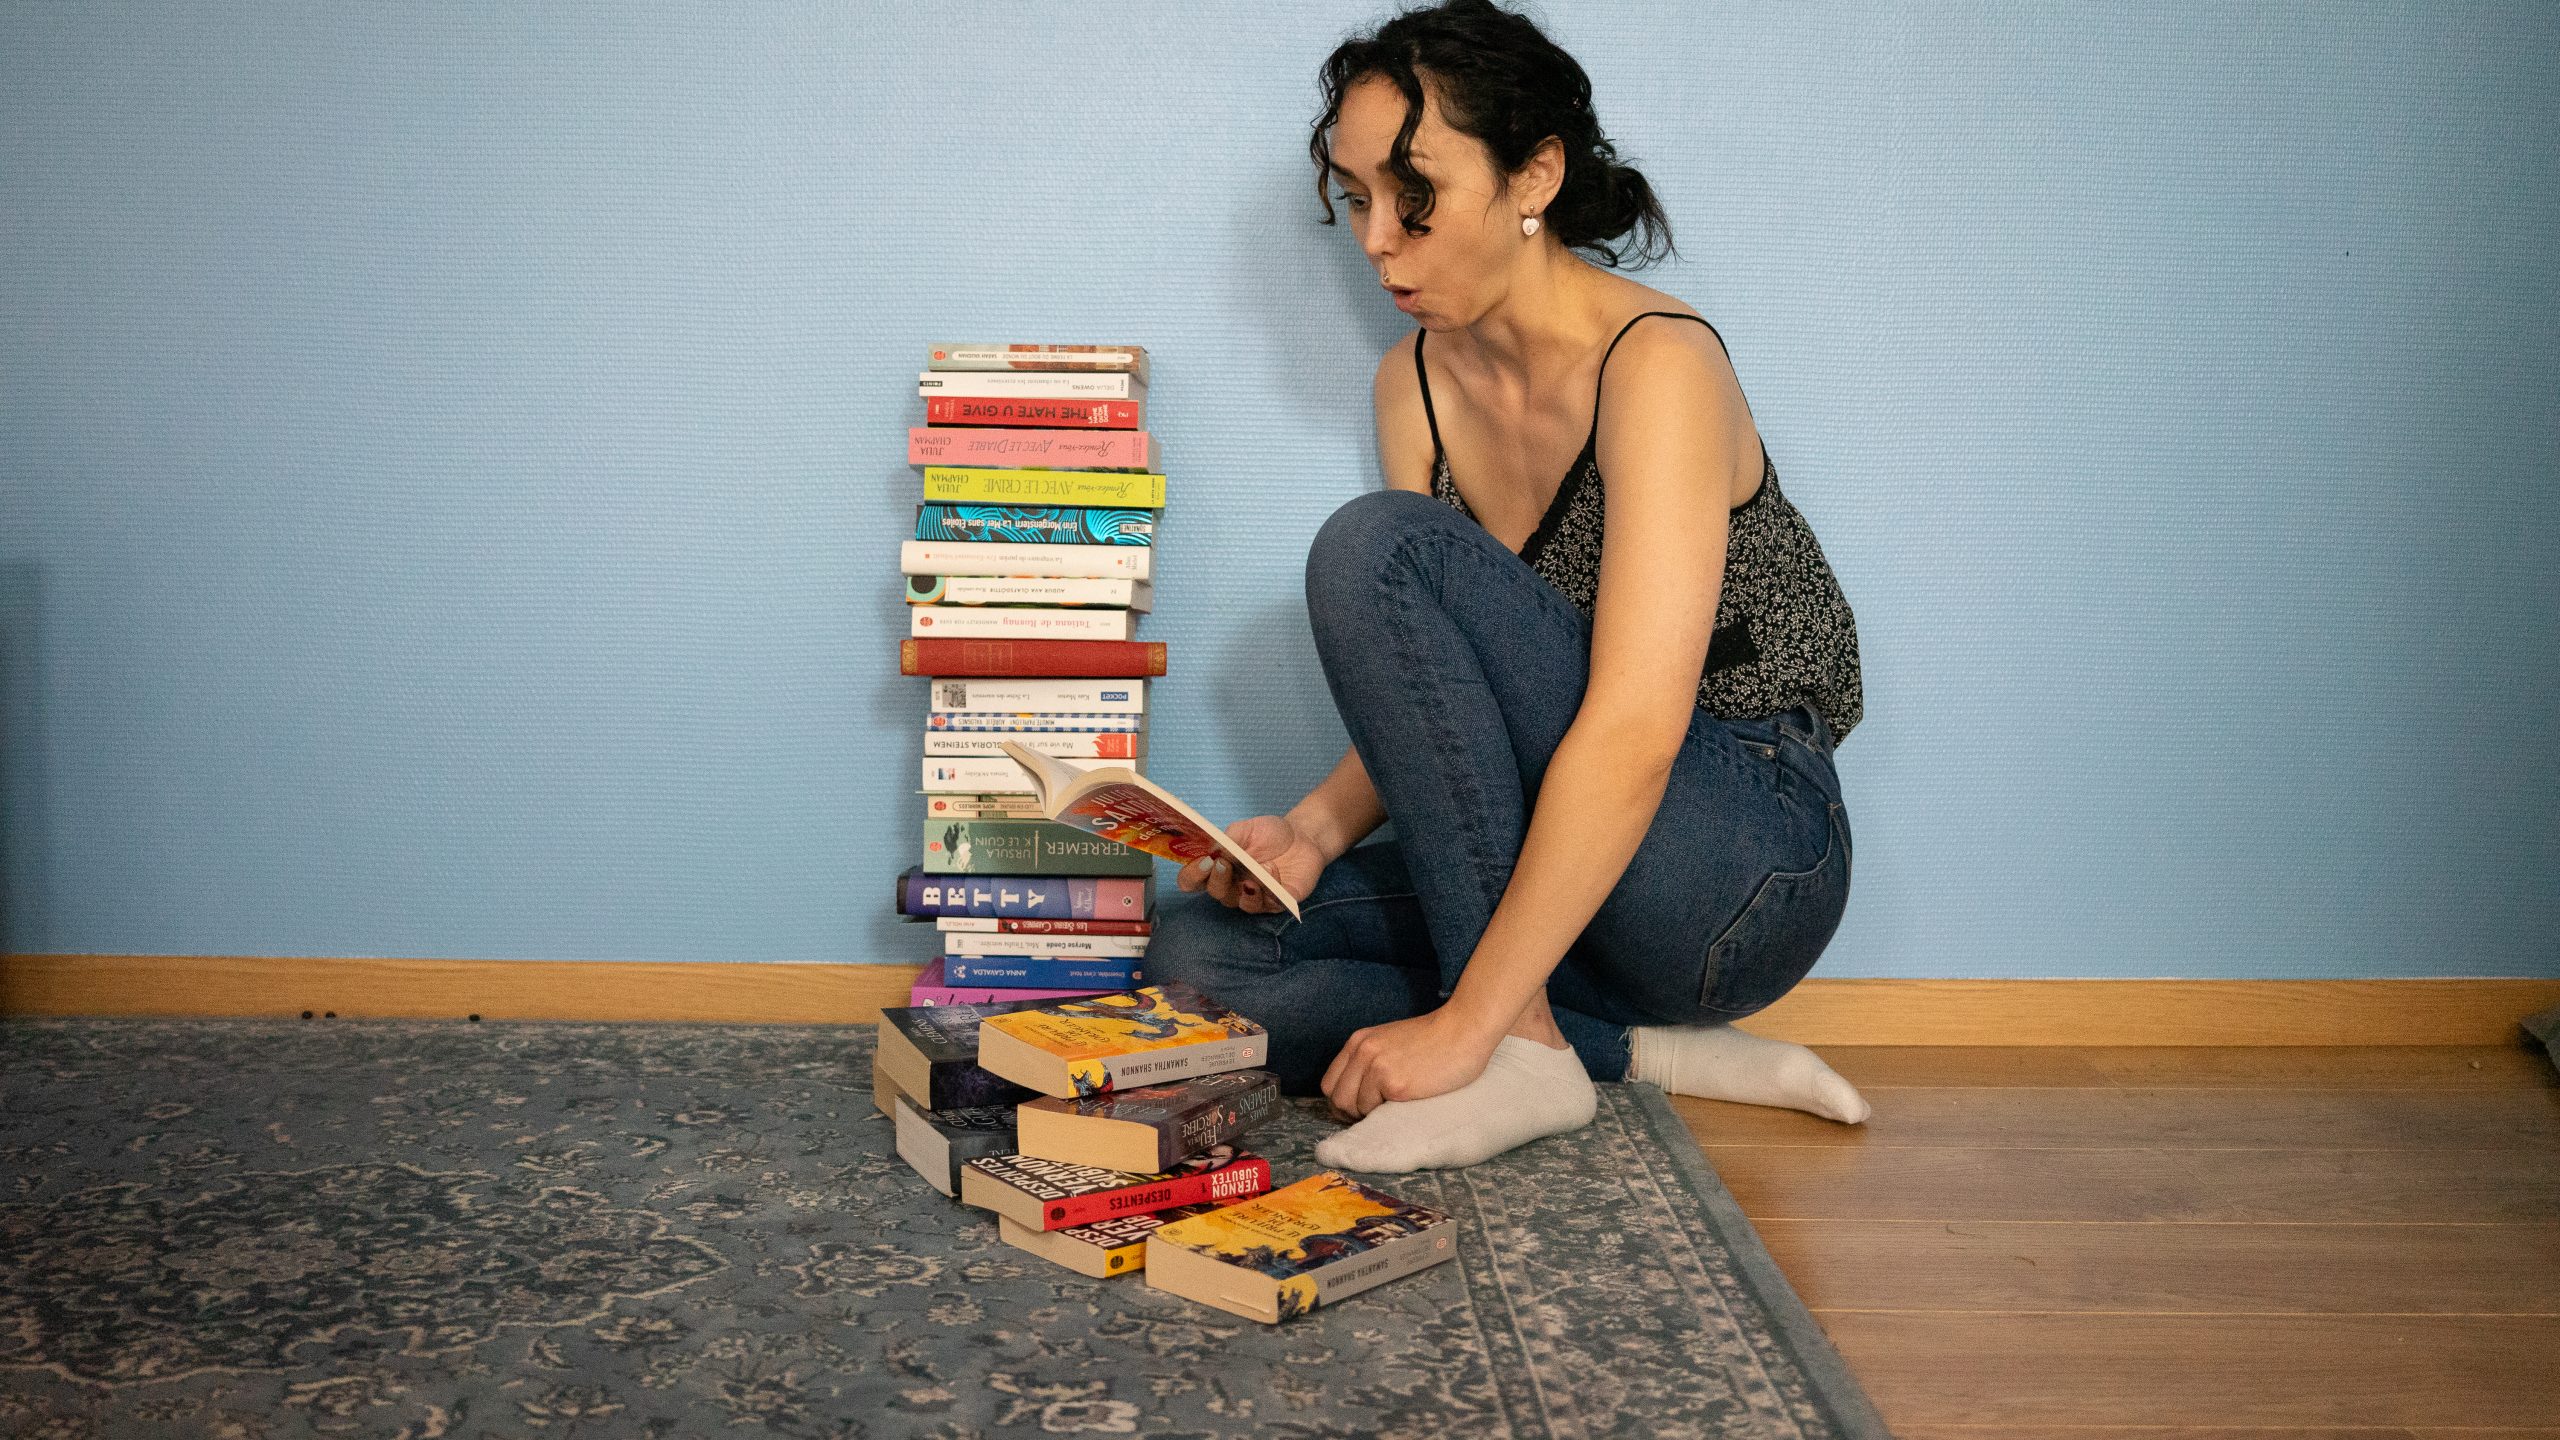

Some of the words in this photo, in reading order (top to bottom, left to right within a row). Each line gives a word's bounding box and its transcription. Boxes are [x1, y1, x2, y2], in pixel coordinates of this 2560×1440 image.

[962, 404, 999, 417] GIVE
[1003, 405, 1014, 416] U
[1018, 406, 1056, 419] HATE
[1061, 407, 1089, 419] THE
[914, 437, 952, 446] CHAPMAN
[967, 439, 1009, 454] DIABLE
[1009, 441, 1023, 451] LE
[1024, 439, 1054, 453] AVEC
[920, 447, 945, 456] JULIA
[1058, 440, 1115, 457] Rendez-vous
[931, 474, 969, 483] CHAPMAN
[937, 484, 961, 493] JULIA
[982, 479, 1021, 494] CRIME
[1023, 480, 1039, 494] LE
[1041, 480, 1074, 496] AVEC
[1077, 481, 1133, 498] Rendez-vous
[967, 519, 985, 527] sans
[987, 519, 1001, 529] Mer
[1003, 519, 1012, 529] La
[1015, 519, 1061, 531] Morgenstern
[1062, 521, 1078, 532] Erin
[1040, 620, 1052, 628] de
[1055, 619, 1090, 629] Tatiana
[933, 741, 969, 749] STEINEM
[1128, 820, 1149, 832] La
[1138, 827, 1162, 841] des
[975, 836, 1005, 847] GUIN
[1007, 837, 1019, 847] LE
[985, 848, 1031, 859] URSULA
[1045, 841, 1129, 856] TERREMER
[923, 887, 1046, 909] BETTY
[1067, 942, 1092, 950] Maryse
[911, 1018, 948, 1045] CLEMENS
[1120, 1063, 1152, 1077] SHANNON
[1154, 1057, 1189, 1071] SAMANTHA
[1239, 1084, 1277, 1115] CLEMENS
[1249, 1104, 1268, 1121] JAMES
[1200, 1125, 1217, 1147] FEU
[971, 1157, 1066, 1200] DESPENTES
[1000, 1155, 1098, 1198] VERNON
[1211, 1167, 1259, 1186] SUBUTEX
[1202, 1183, 1208, 1194] 1
[1212, 1179, 1259, 1198] VERNON
[1109, 1188, 1171, 1210] DESPENTES
[1356, 1257, 1389, 1275] SAMANTHA
[1326, 1270, 1356, 1288] SHANNON
